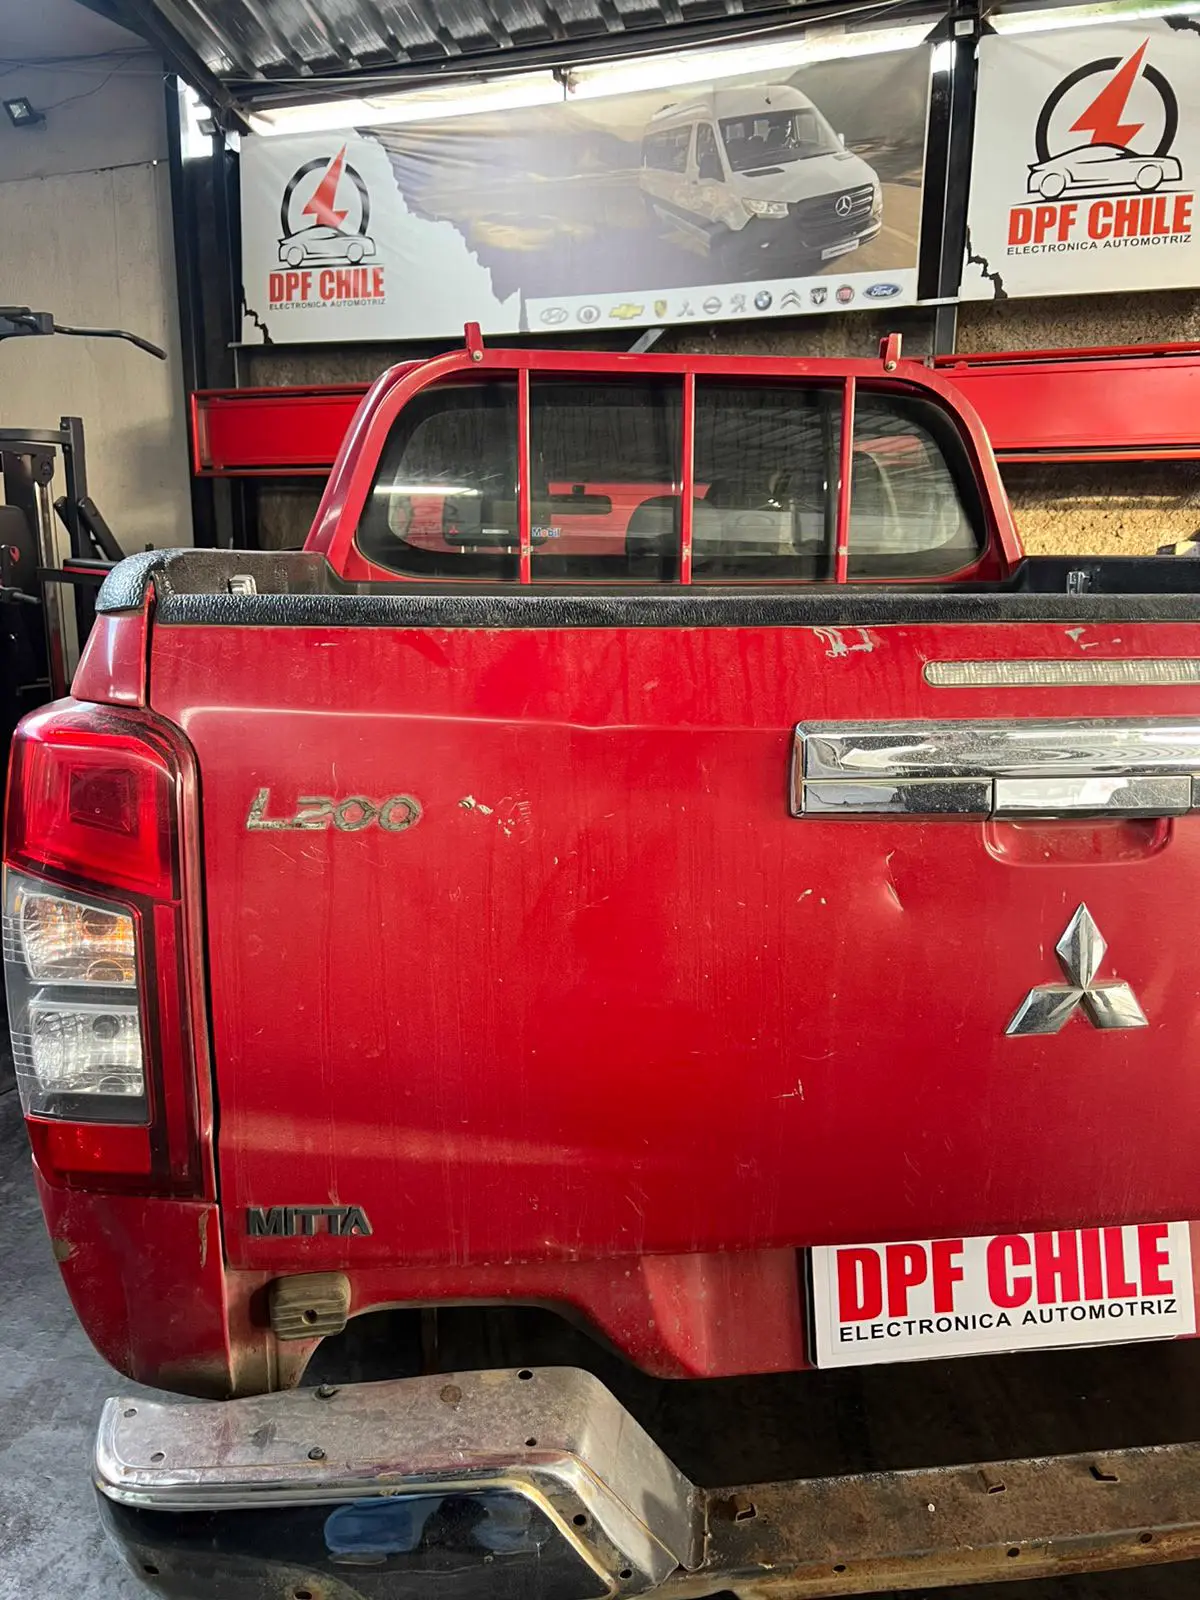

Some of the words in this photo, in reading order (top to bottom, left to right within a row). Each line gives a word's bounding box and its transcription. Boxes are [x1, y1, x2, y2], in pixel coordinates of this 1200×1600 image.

[1008, 203, 1078, 246] DPF
[1087, 194, 1194, 240] CHILE
[1007, 240, 1098, 256] ELECTRONICA
[1103, 234, 1192, 249] AUTOMOTRIZ
[269, 271, 313, 302] DPF
[320, 267, 385, 301] CHILE
[870, 285, 895, 296] Ford
[269, 301, 327, 311] ELECTRONICA
[330, 299, 385, 307] AUTOMOTRIZ
[532, 527, 561, 537] Mobil
[246, 787, 423, 832] L200
[246, 1205, 373, 1236] MITTA
[836, 1239, 964, 1323] DPF
[986, 1224, 1174, 1309] CHILE
[839, 1313, 1012, 1342] ELECTRONICA
[1022, 1299, 1177, 1325] AUTOMOTRIZ
